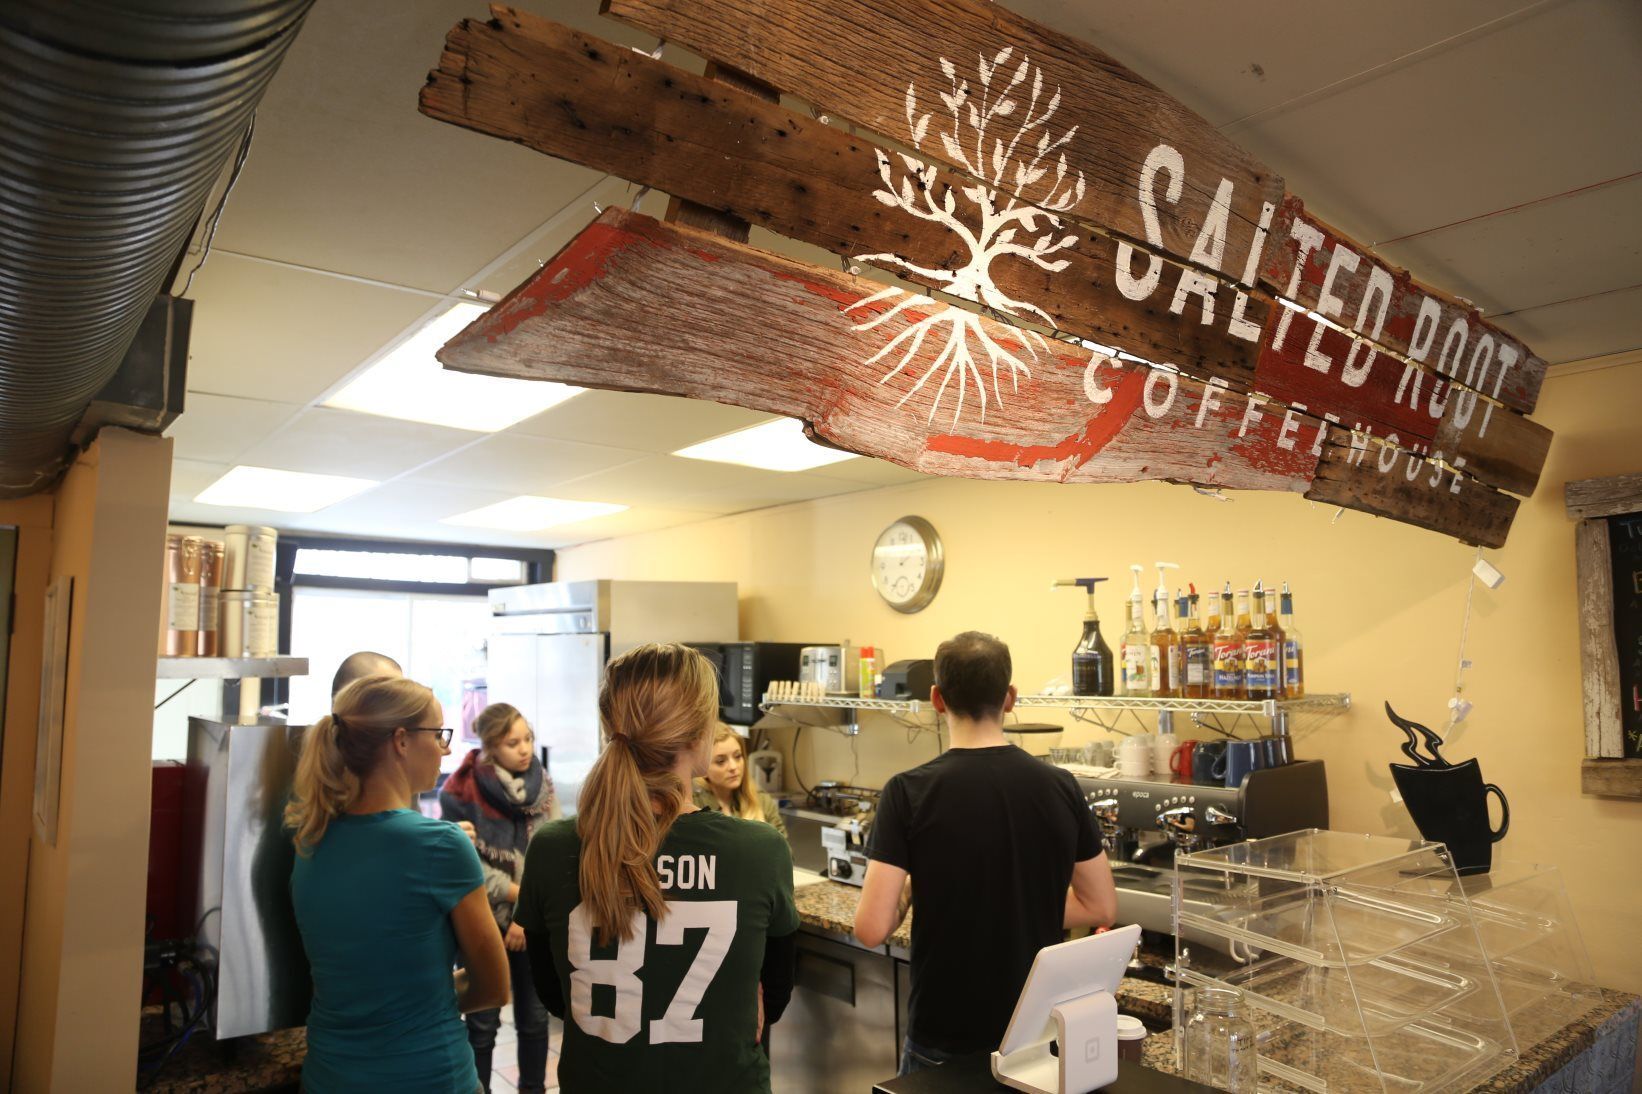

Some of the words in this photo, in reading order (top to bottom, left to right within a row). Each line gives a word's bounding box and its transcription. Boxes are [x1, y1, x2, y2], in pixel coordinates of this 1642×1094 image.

[1116, 144, 1394, 388] SALTED
[1394, 295, 1519, 438] ROOT
[568, 900, 738, 1045] 87
